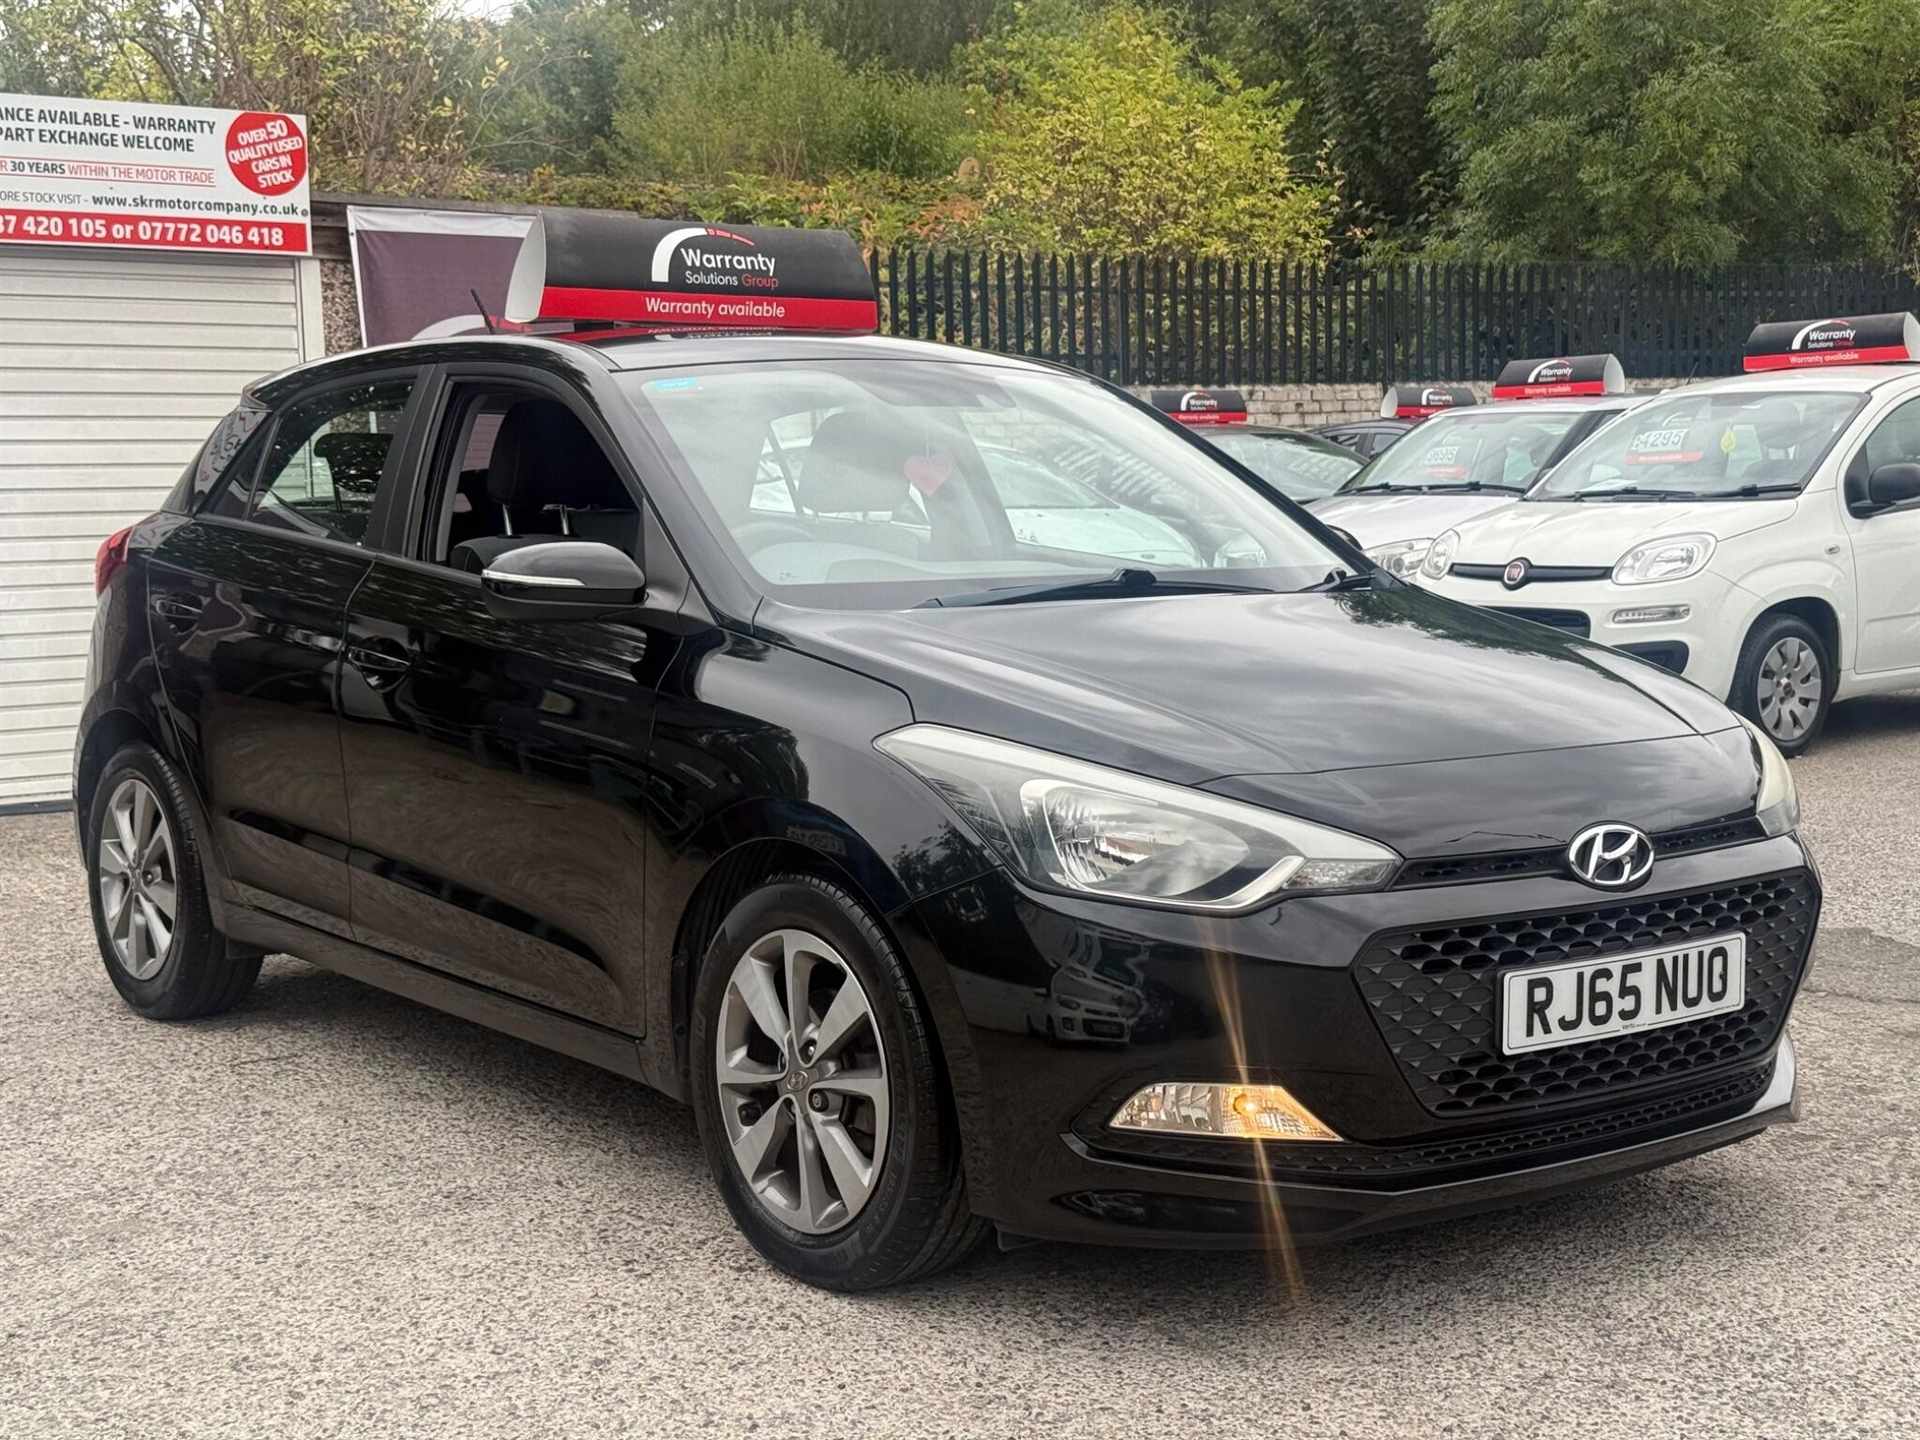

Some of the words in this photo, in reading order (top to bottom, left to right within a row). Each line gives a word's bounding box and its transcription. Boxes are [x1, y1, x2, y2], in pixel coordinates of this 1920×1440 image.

[38, 109, 120, 128] AVAILABLE
[133, 115, 216, 135] WARRANTY
[237, 129, 267, 146] OVER
[266, 119, 288, 139] 50
[38, 128, 119, 147] EXCHANGE
[122, 134, 195, 152] WELCOME
[228, 141, 275, 164] QUALITY
[275, 137, 303, 153] USED
[10, 161, 25, 172] 30
[27, 161, 66, 174] YEARS
[68, 164, 109, 178] WITHIN
[111, 166, 133, 180] THE
[135, 167, 177, 182] MOTOR
[178, 170, 215, 184] TRADE
[251, 157, 280, 174] CARS
[279, 154, 292, 168] IN
[257, 169, 295, 188] STOCK
[22, 191, 56, 204] STOCK
[57, 193, 82, 205] VISIT
[92, 195, 299, 218] www.skrmotorcompany.co.uk
[22, 216, 63, 236] 420
[68, 217, 107, 238] 105
[112, 224, 133, 240] or
[138, 221, 202, 243] 07772
[205, 224, 244, 244] 046
[247, 227, 284, 246] 418
[681, 247, 776, 277] Warranty
[685, 270, 738, 286] Solutions
[742, 274, 779, 290] Group
[646, 297, 715, 318] Warranty
[718, 301, 786, 318] available
[1807, 341, 1834, 349] Solutions
[1808, 328, 1857, 341] Warranty
[1789, 355, 1823, 364] Warranty
[1823, 352, 1859, 361] available
[1540, 367, 1573, 376] Warranty
[1188, 398, 1218, 407] Warranty
[1525, 962, 1643, 1037] RJ65
[1655, 946, 1729, 1015] NUO
